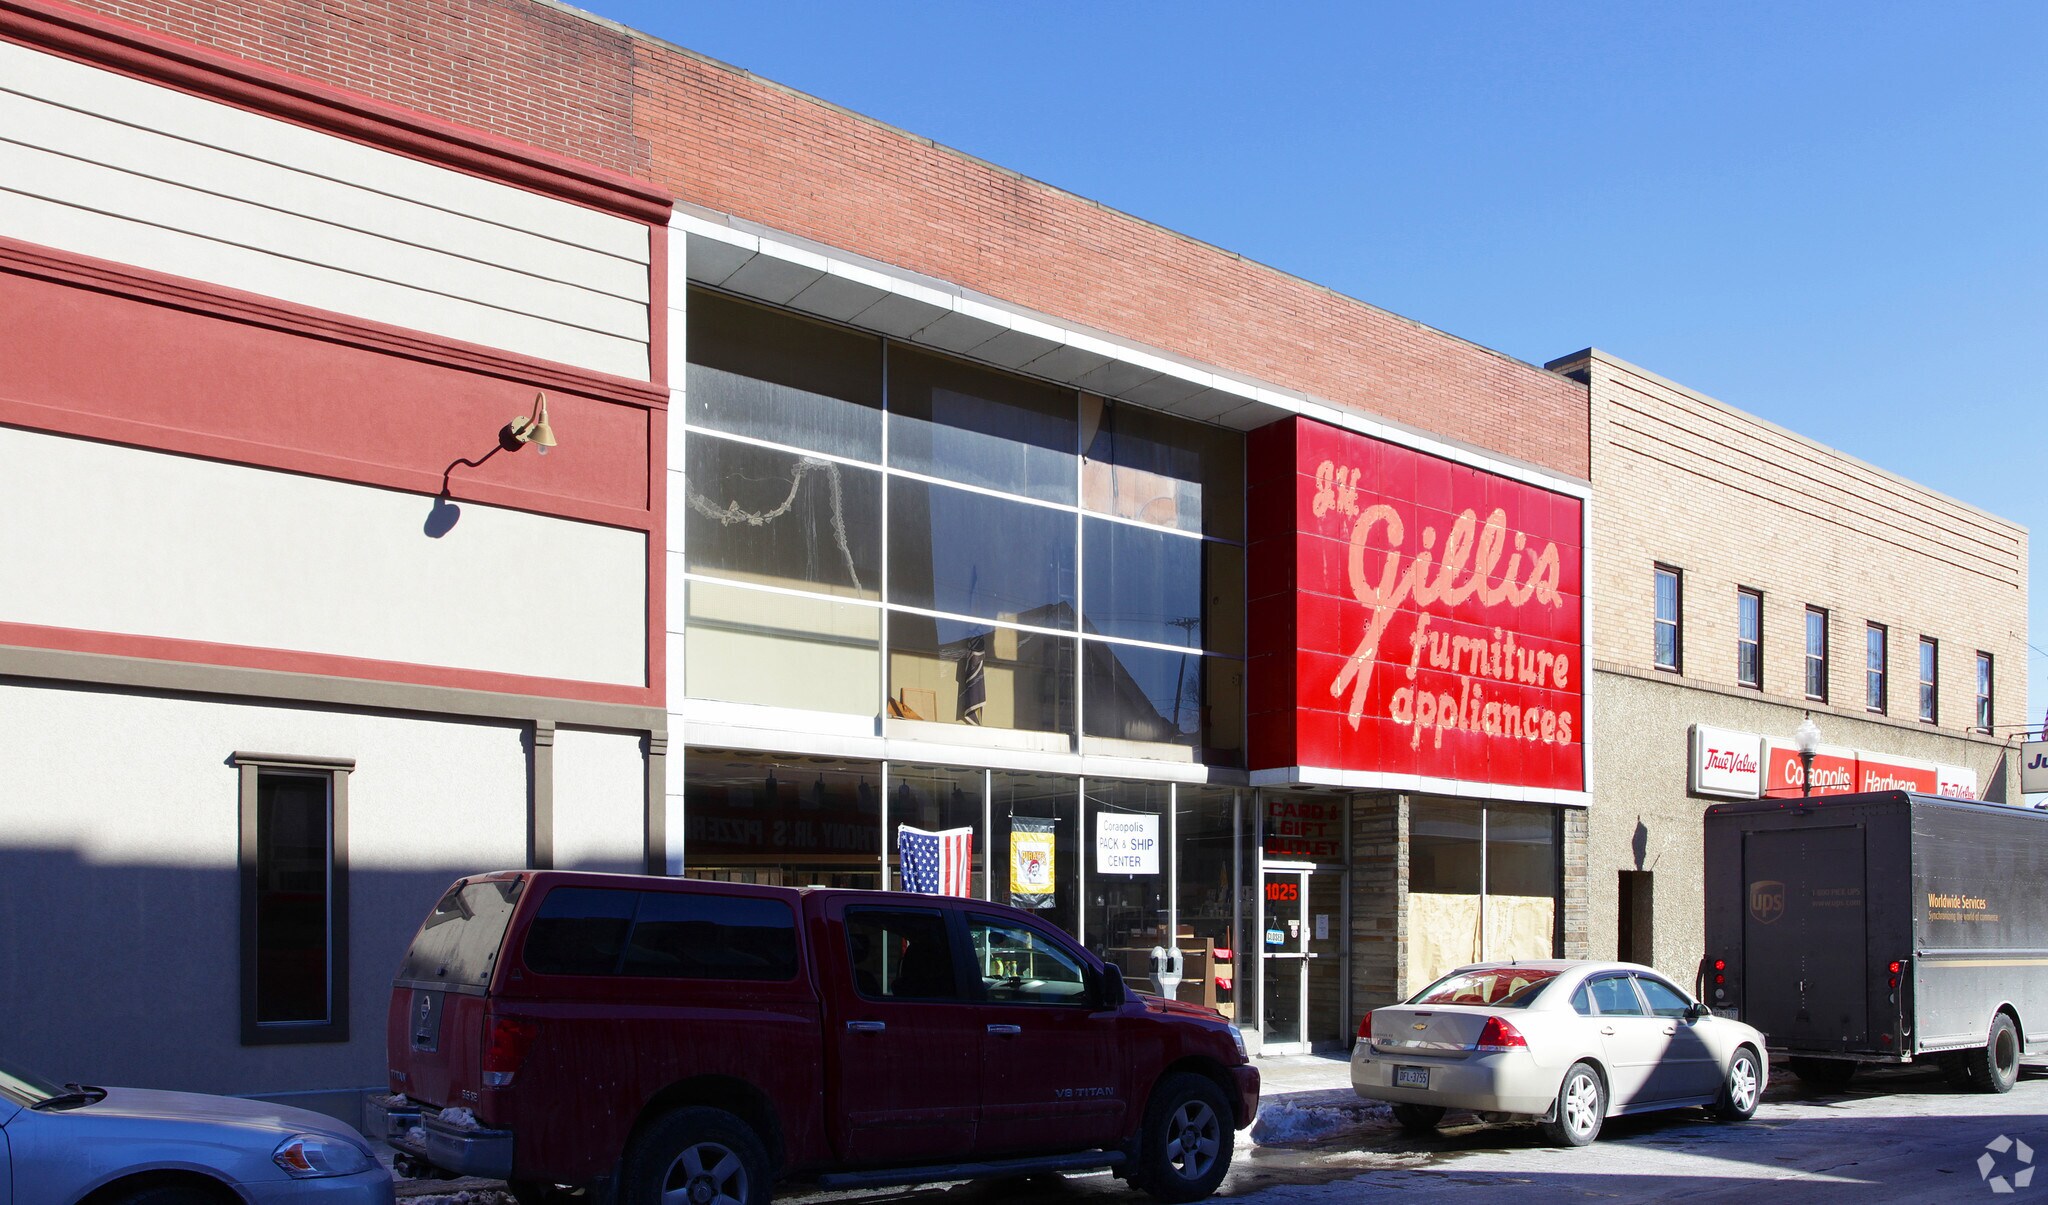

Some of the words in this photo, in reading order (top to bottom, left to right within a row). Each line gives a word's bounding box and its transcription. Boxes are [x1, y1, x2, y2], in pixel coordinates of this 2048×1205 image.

[1330, 504, 1563, 732] Gillis
[1405, 611, 1569, 690] furniture
[1389, 676, 1573, 751] appliances
[1784, 758, 1850, 793] Coaopolis
[1864, 769, 1917, 793] Hardware
[1268, 801, 1325, 819] CARD
[1329, 804, 1338, 820] &
[1103, 819, 1144, 834] Coraopolis
[1280, 820, 1328, 838] GIFT
[1099, 837, 1119, 850] PACK
[1122, 841, 1127, 849] &
[1130, 838, 1154, 851] SHIP
[1266, 838, 1340, 856] OUTLET
[1107, 855, 1141, 868] CENTER
[1265, 883, 1299, 900] 1025
[1751, 893, 1783, 918] ups
[1927, 893, 1961, 909] Worldwide
[1961, 894, 1987, 910] Services
[1054, 1088, 1073, 1098] V8
[1075, 1086, 1114, 1097] TITAN
